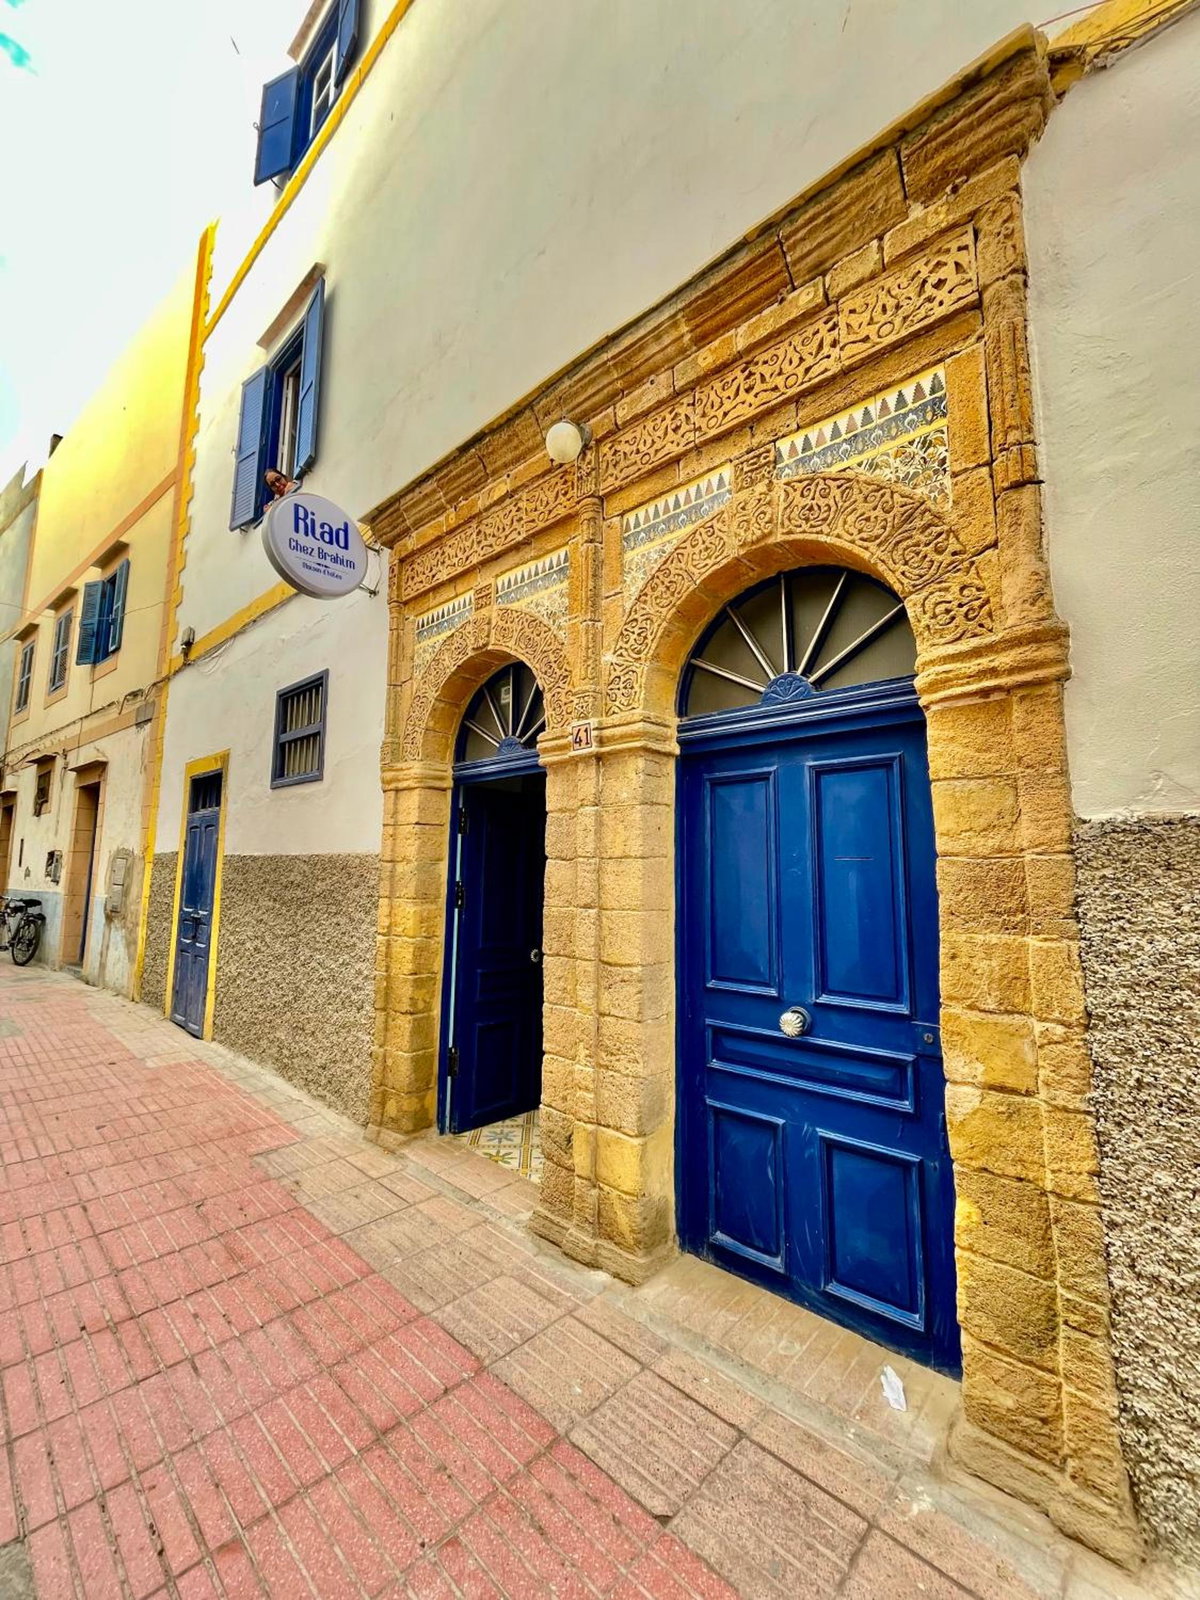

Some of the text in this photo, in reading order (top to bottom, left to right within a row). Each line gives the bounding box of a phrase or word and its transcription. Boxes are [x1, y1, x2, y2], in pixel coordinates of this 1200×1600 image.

[294, 503, 349, 551] Riad
[288, 537, 355, 570] Chez Brahim
[574, 727, 590, 747] 41
